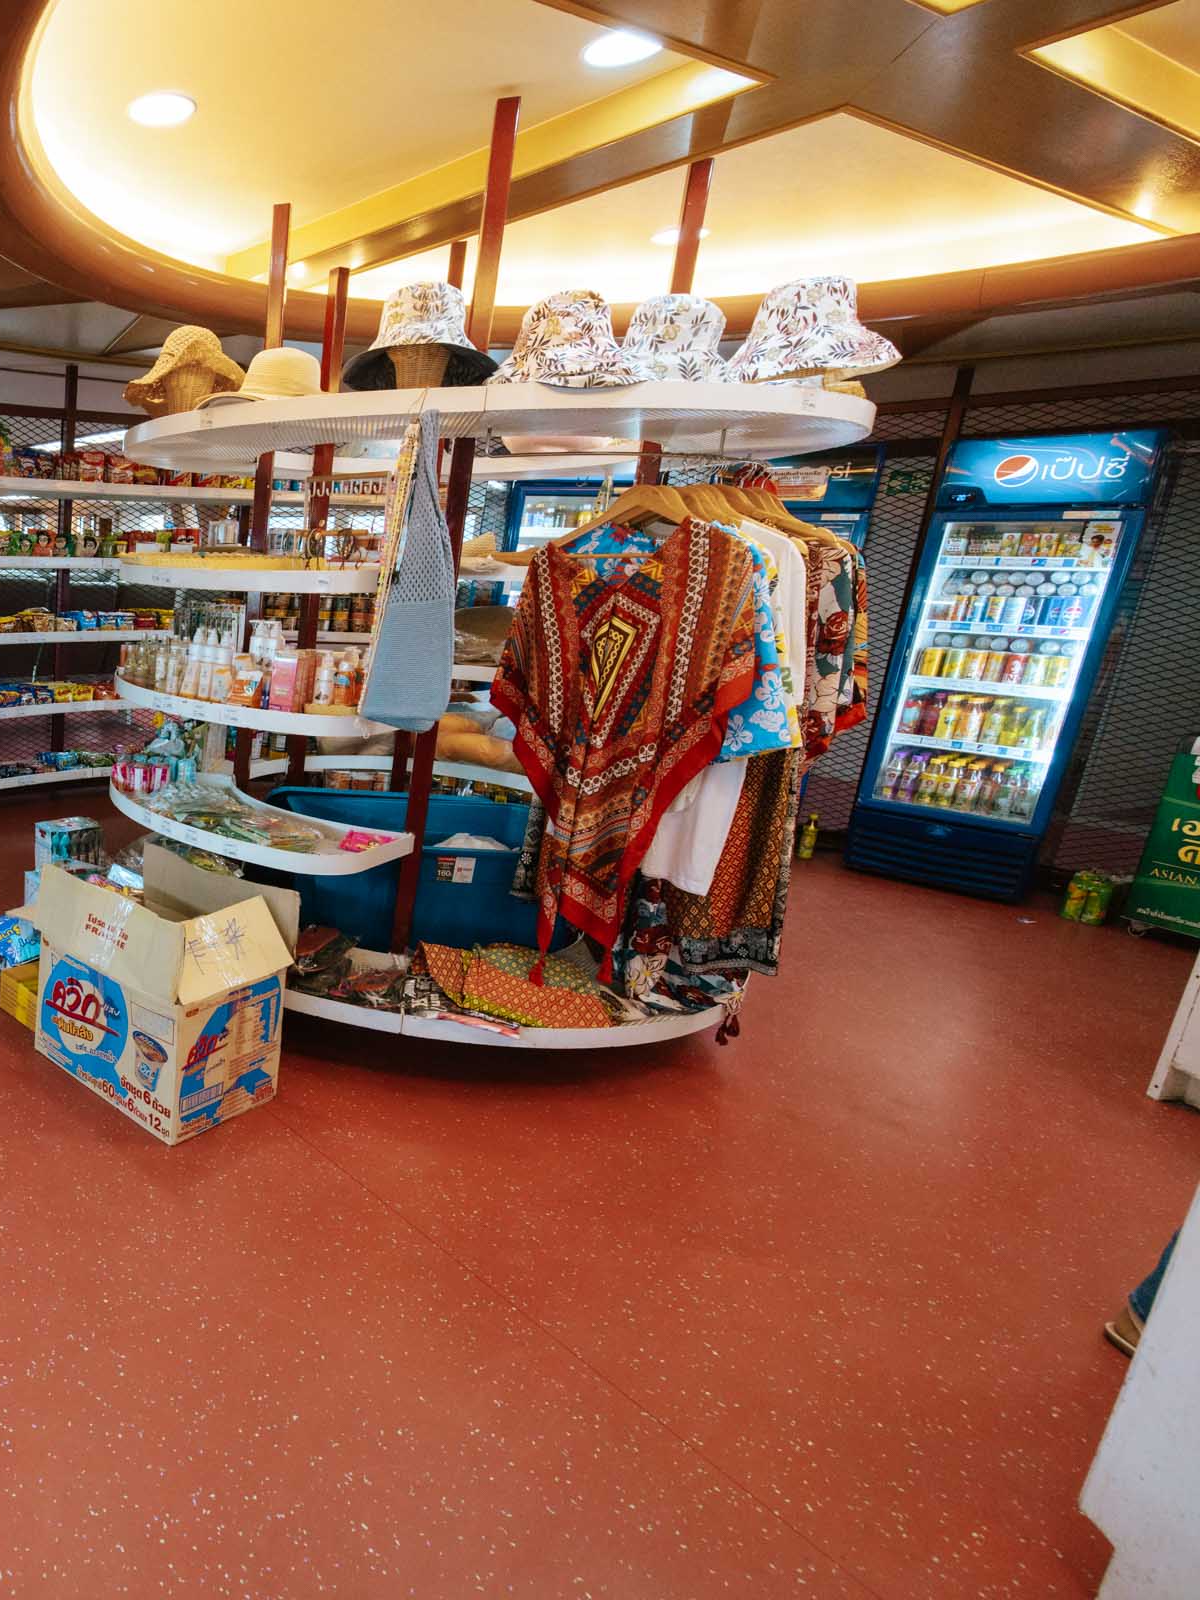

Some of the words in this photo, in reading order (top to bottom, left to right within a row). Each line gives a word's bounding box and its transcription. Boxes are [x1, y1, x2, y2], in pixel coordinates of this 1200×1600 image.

[1040, 452, 1131, 481] เป๊ปซี่
[1151, 867, 1197, 886] ASIAN
[102, 1079, 115, 1098] 60
[149, 1113, 161, 1132] 12
[143, 1090, 151, 1105] 6
